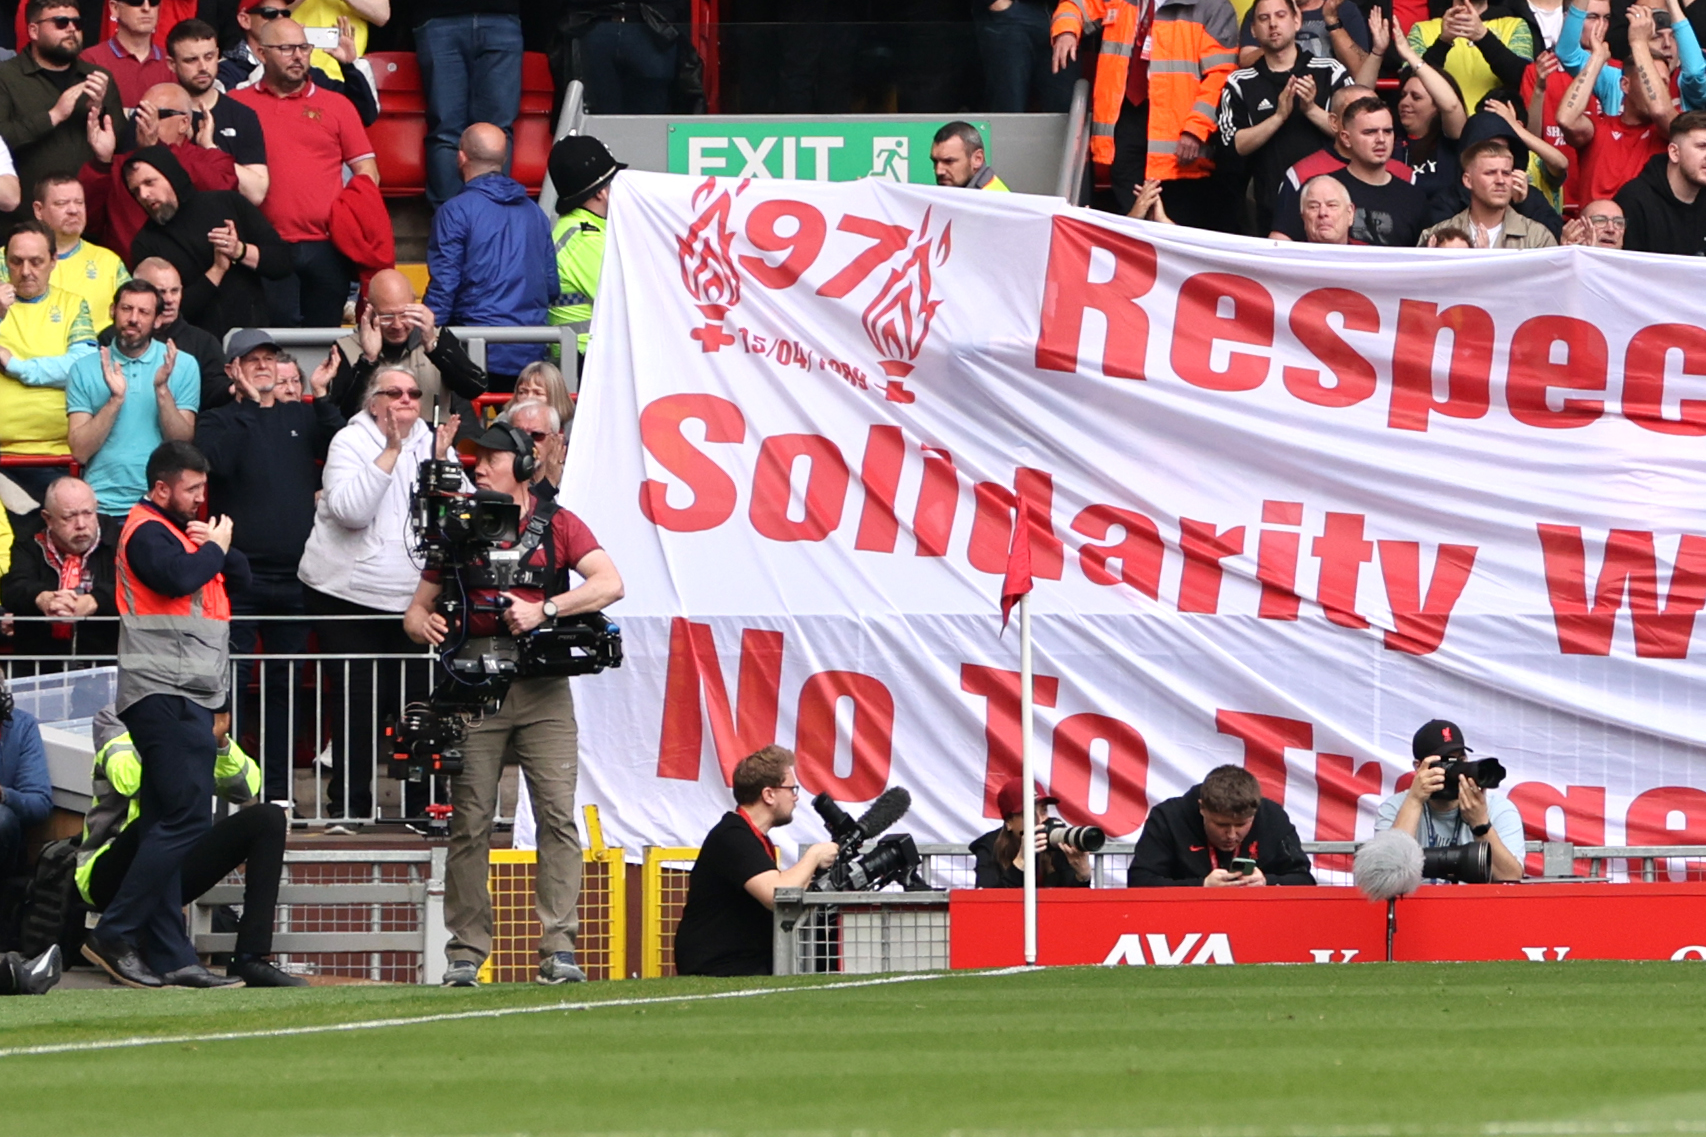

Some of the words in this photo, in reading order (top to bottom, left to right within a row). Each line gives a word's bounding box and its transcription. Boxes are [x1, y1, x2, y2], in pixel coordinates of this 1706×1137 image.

[687, 136, 844, 180] EXIT
[738, 199, 914, 299] 97
[639, 393, 1479, 656] Solidarity
[656, 616, 895, 803] No
[961, 663, 1150, 839] To
